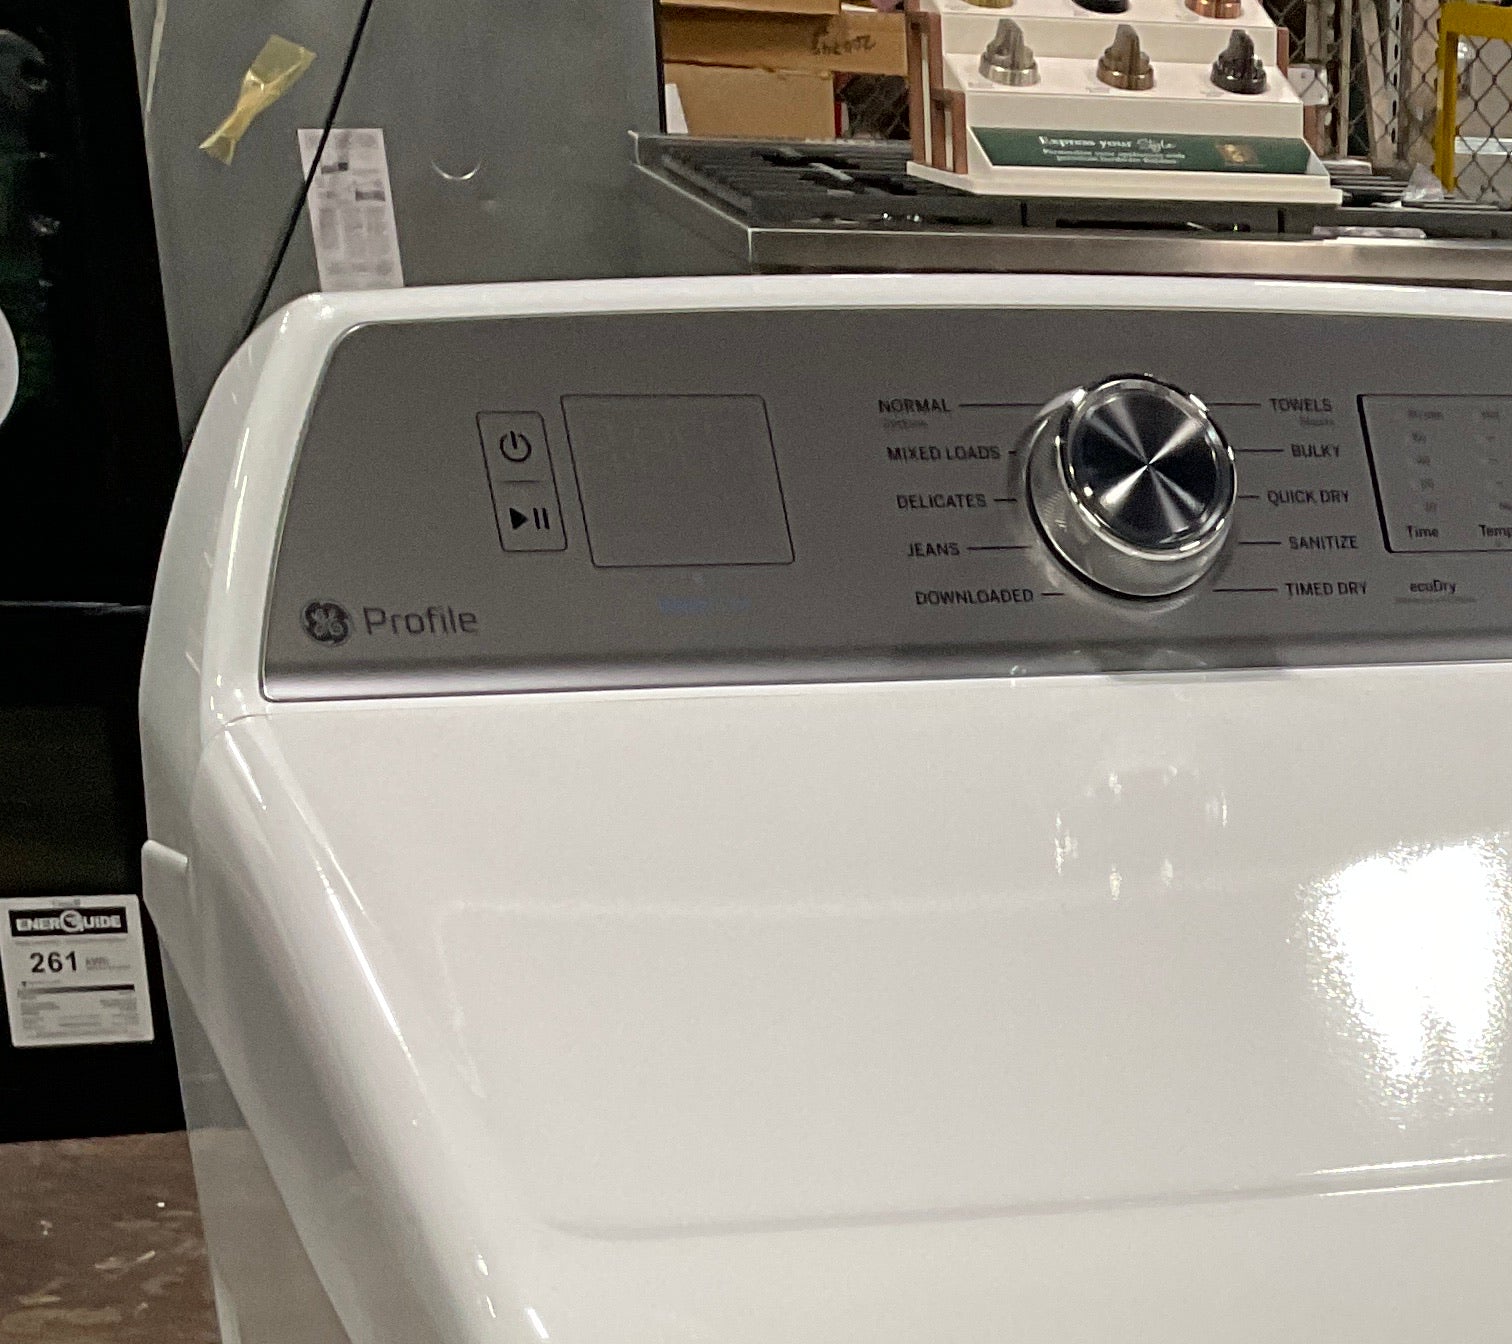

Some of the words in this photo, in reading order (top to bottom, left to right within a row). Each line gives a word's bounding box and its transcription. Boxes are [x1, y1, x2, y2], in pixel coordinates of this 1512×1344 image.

[878, 398, 951, 413] NORMAL
[1268, 397, 1333, 412] TOWELS
[886, 446, 942, 461] MIXED
[946, 445, 1000, 460] LOADS
[1290, 443, 1340, 458] BULKY
[896, 493, 987, 509] DELICATES
[1267, 490, 1317, 506] QUICK
[1320, 489, 1350, 503] DRY
[1407, 525, 1439, 538] Time
[907, 542, 960, 557] JEANS
[1288, 535, 1359, 550] SANITIZE
[1285, 582, 1333, 597] TIMED
[1337, 581, 1367, 595] DRY
[1410, 579, 1456, 594] ecoDry
[915, 588, 1033, 605] DOWNLOADED
[363, 606, 479, 635] Profile
[29, 951, 78, 974] 261
